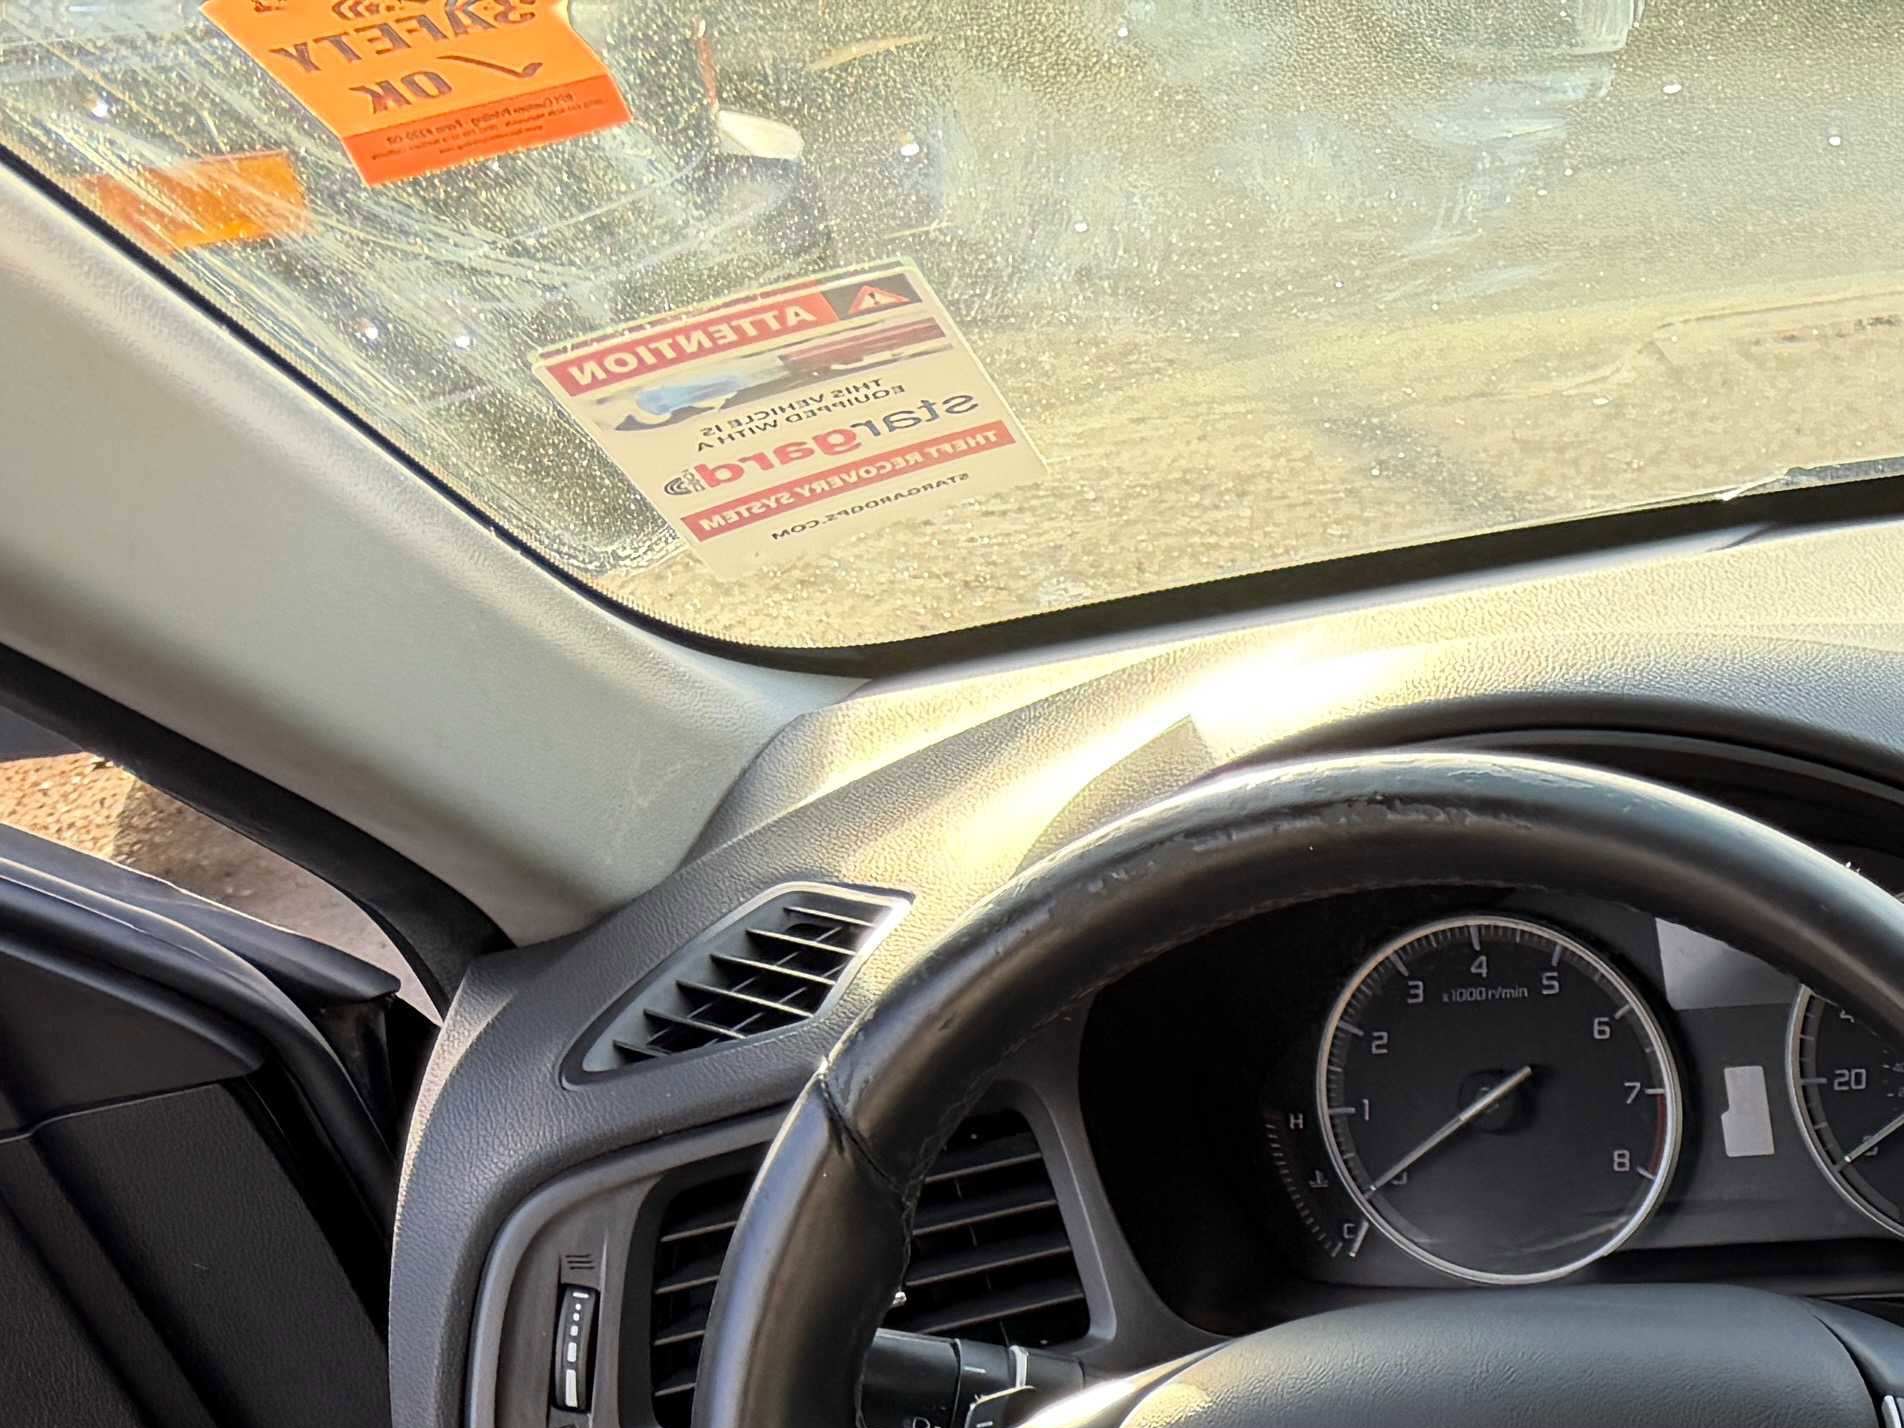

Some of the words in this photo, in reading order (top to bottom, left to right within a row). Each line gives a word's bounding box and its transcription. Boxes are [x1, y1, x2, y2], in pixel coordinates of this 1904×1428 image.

[1470, 956, 1489, 978] 4
[1407, 980, 1425, 1004] 3
[1488, 985, 1529, 1001] r/min
[1542, 972, 1560, 995] 5
[1593, 1018, 1611, 1040] 6
[1371, 1032, 1389, 1055] 2
[1833, 1068, 1867, 1091] 20
[1623, 1081, 1642, 1105] 7
[1289, 1113, 1304, 1130] H
[1361, 1099, 1371, 1122] 1
[1613, 1149, 1631, 1173] 8
[1343, 1222, 1356, 1240] C
